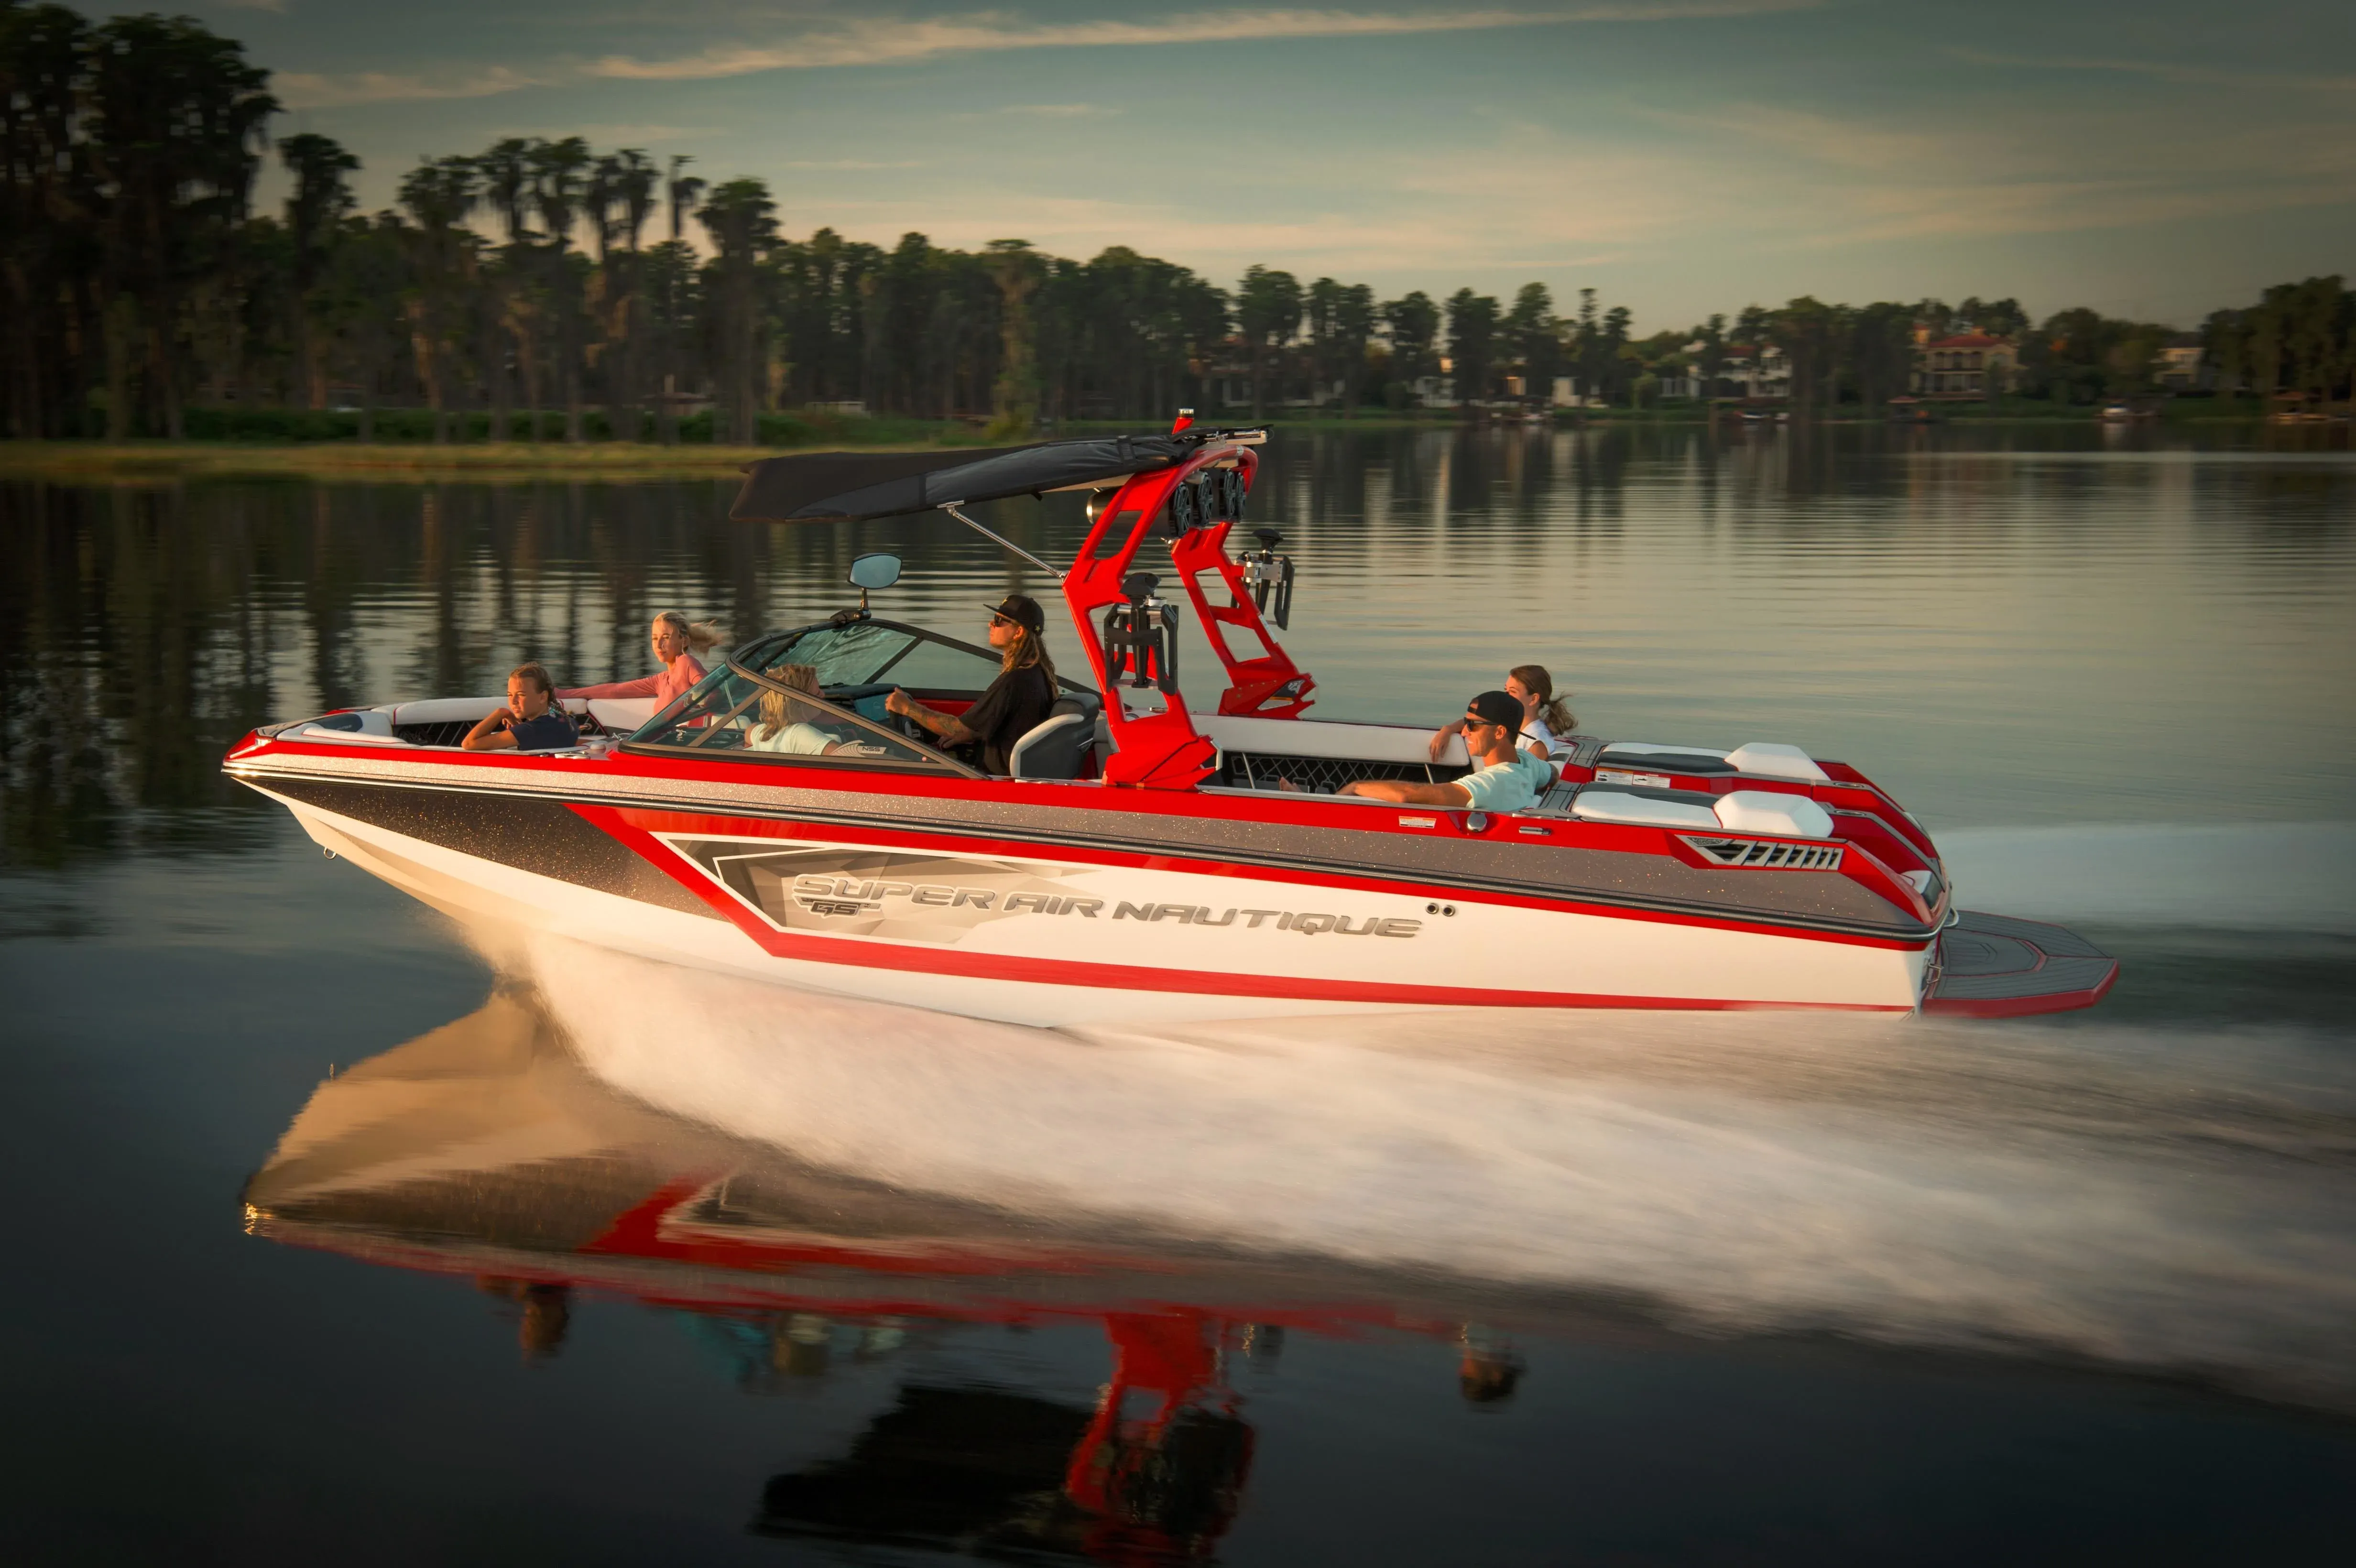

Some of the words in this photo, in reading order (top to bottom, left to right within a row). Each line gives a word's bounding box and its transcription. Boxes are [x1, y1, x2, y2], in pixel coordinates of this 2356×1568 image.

[793, 876, 995, 910] SUPER
[1003, 893, 1103, 918] AIR
[1112, 902, 1423, 938] NAUTIQUE
[811, 902, 858, 916] GS
